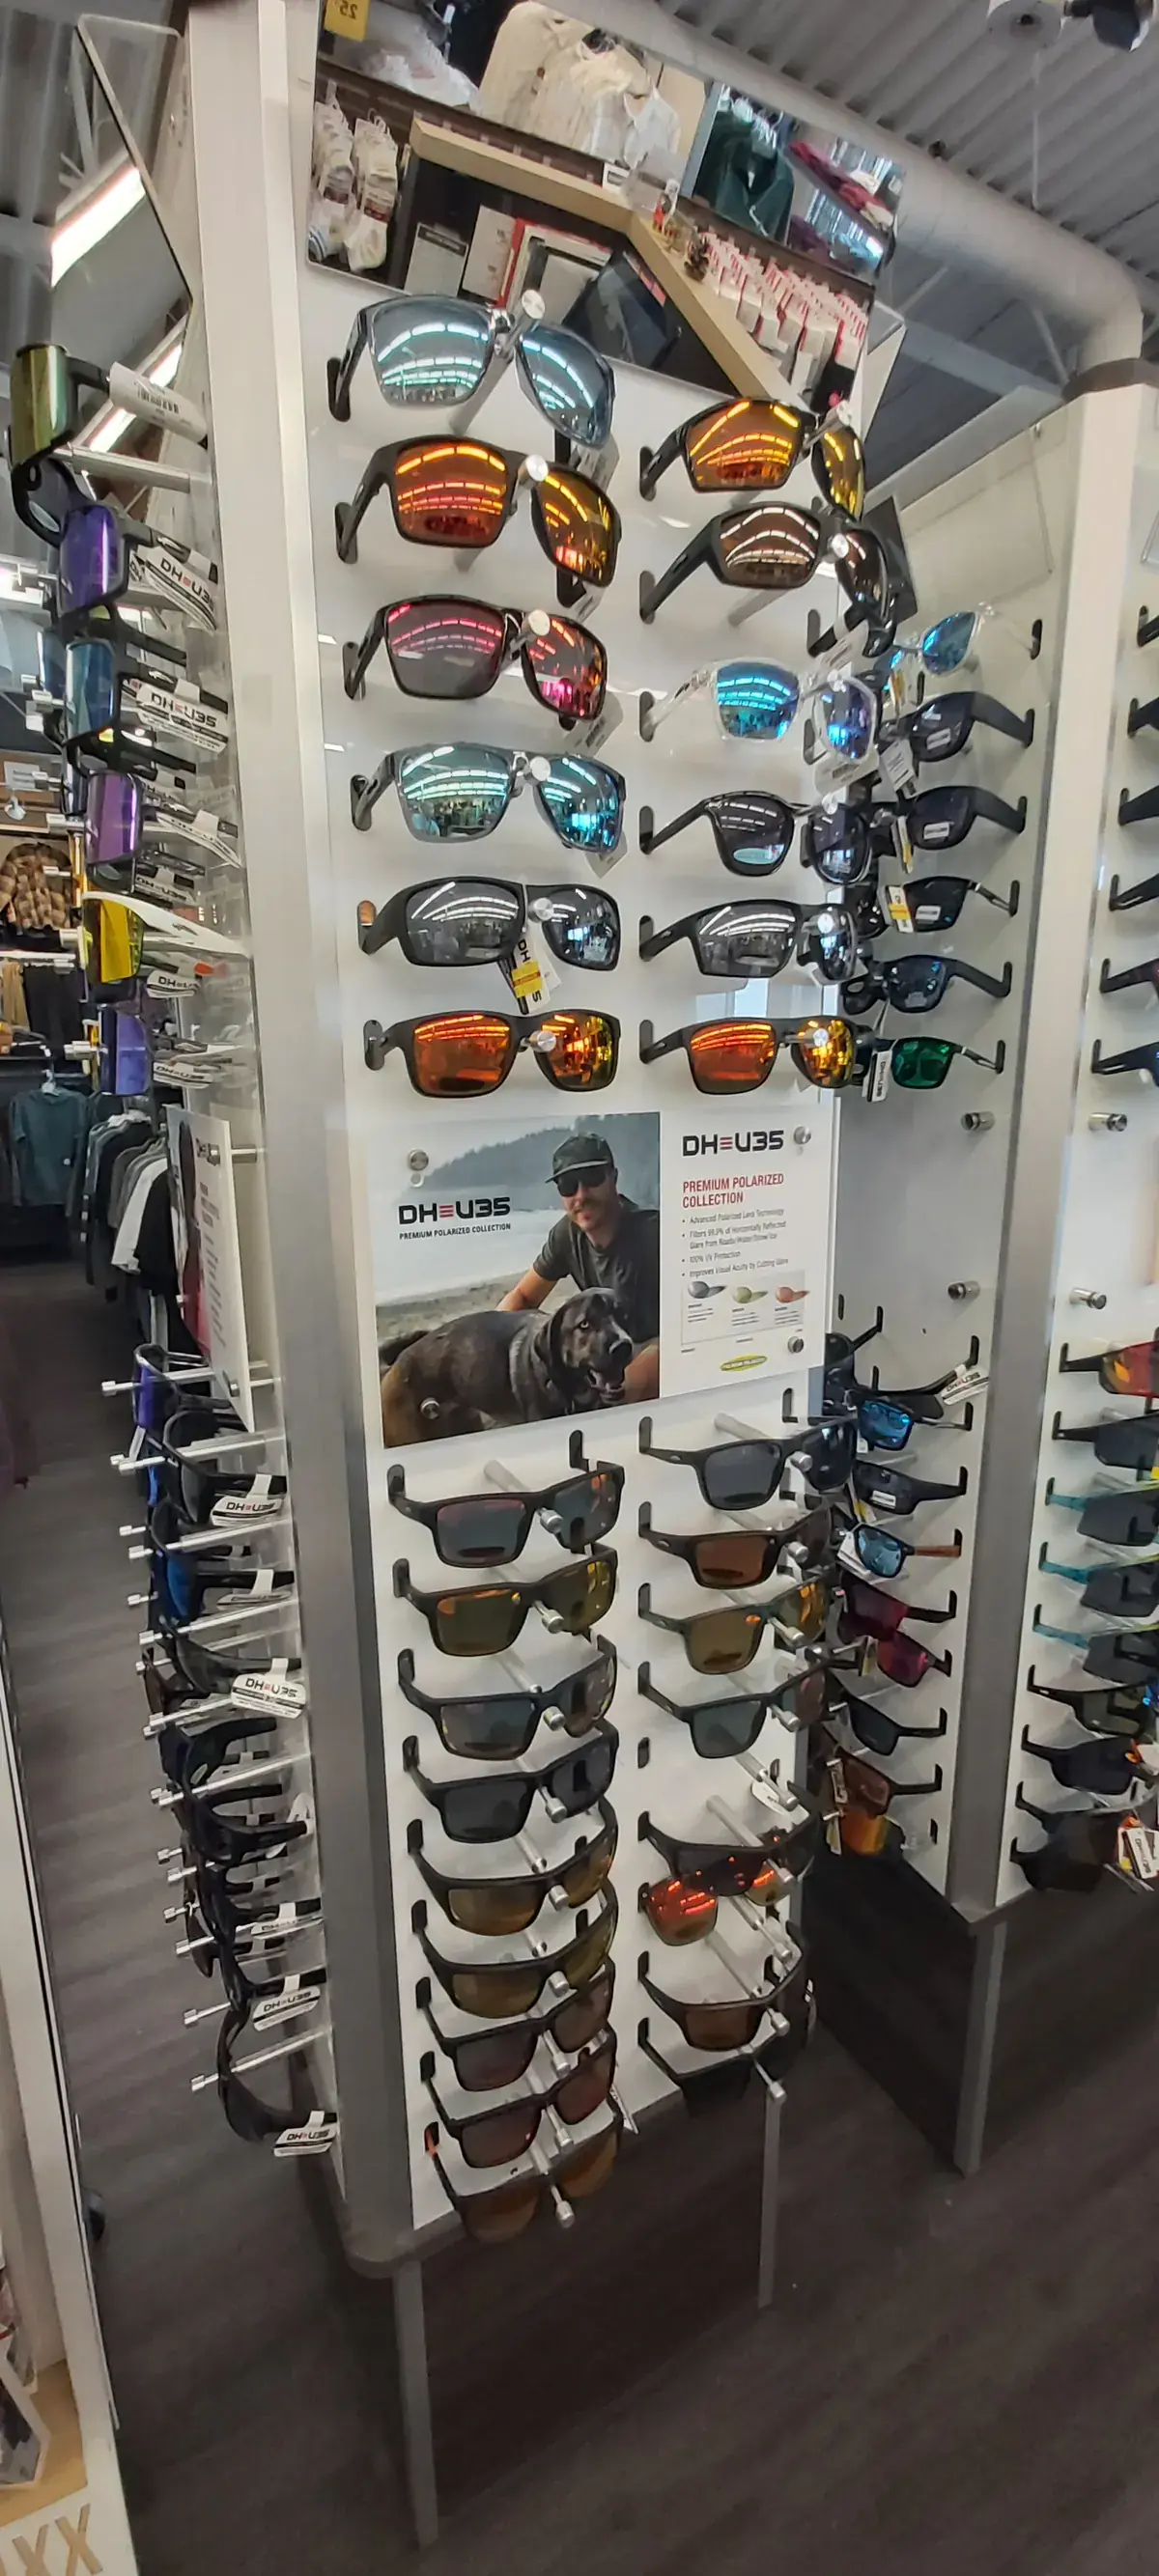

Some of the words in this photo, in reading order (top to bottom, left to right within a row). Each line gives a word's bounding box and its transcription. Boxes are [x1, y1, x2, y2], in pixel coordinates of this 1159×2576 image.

[683, 1177, 730, 1194] PREMIUM
[732, 1173, 784, 1189] POLARIZED
[683, 1191, 744, 1209] COLLECTION
[399, 1230, 433, 1241] PREMIUM
[434, 1226, 471, 1237] POLARIZED
[471, 1222, 511, 1234] COLLECTION
[0, 2503, 103, 2576] XX
